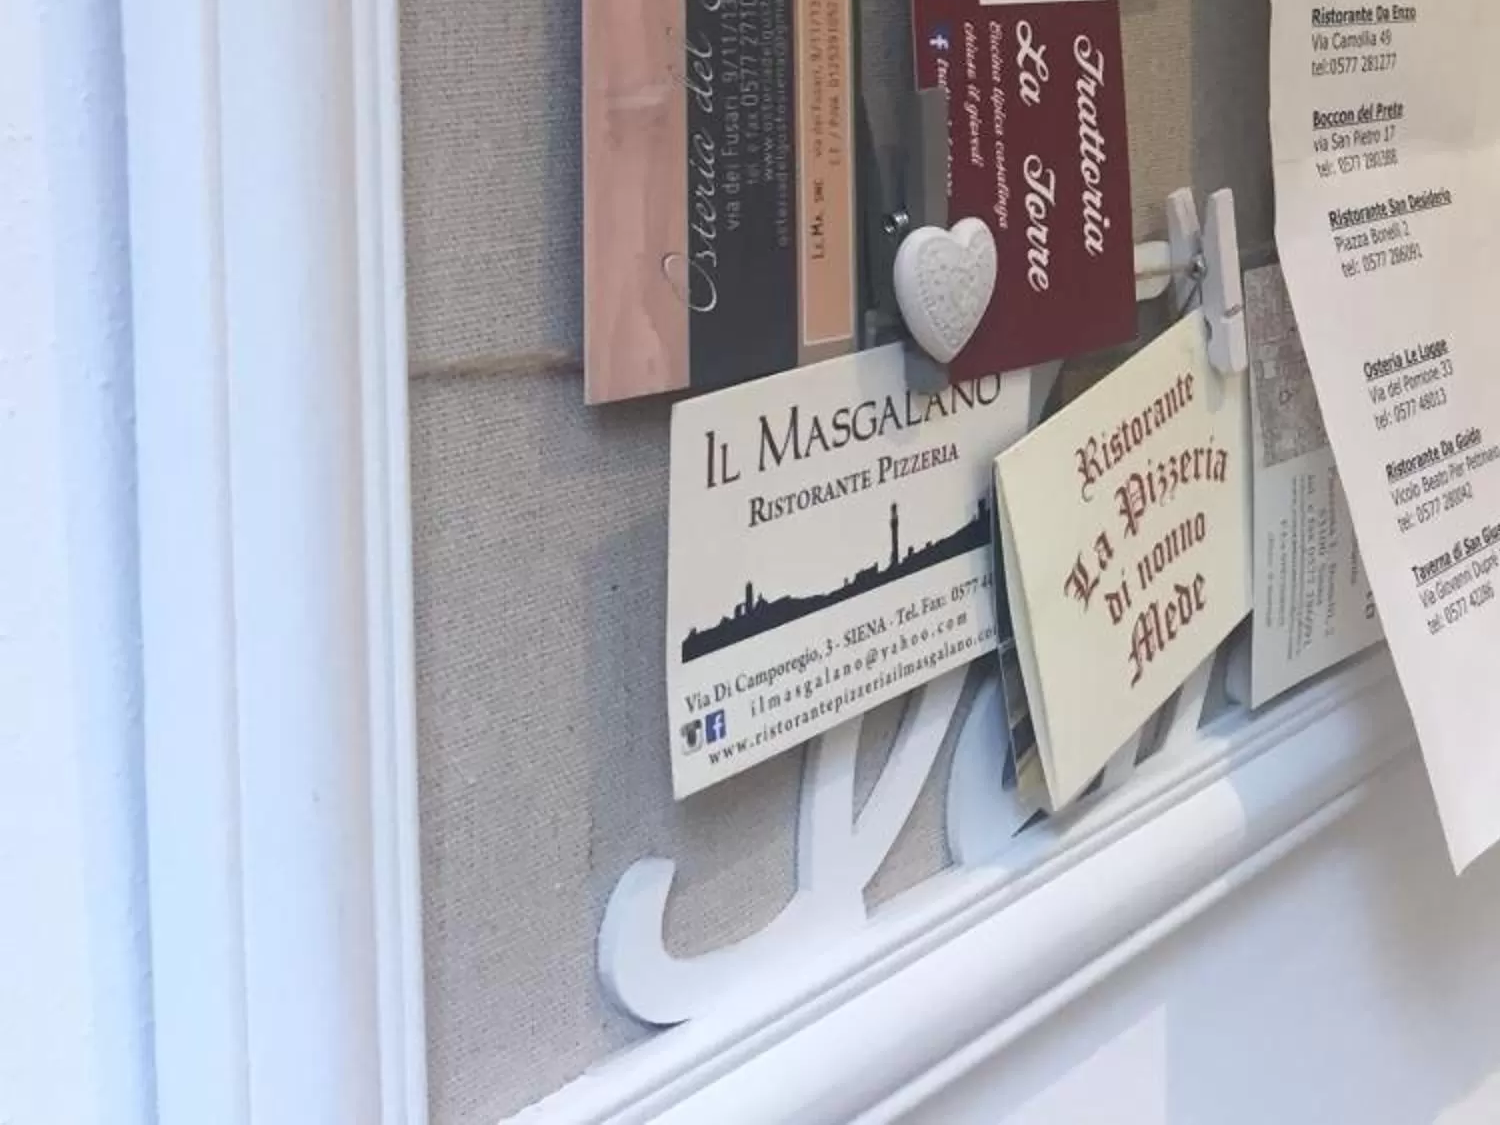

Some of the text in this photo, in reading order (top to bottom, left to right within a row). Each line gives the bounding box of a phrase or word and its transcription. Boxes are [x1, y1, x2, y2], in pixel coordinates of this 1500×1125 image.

[1311, 6, 1374, 26] Ristorante
[1391, 4, 1417, 22] Enzo
[1311, 33, 1329, 52] Via
[668, 32, 715, 114] del
[740, 55, 760, 107] 0577
[990, 86, 1009, 136] tipica
[1313, 109, 1355, 129] Boccon
[1357, 102, 1374, 124] del
[1015, 19, 1057, 293] La Torre
[1072, 34, 1111, 259] Trattoria
[1331, 131, 1351, 151] San
[1383, 124, 1397, 143] 17
[720, 162, 741, 195] dei
[991, 140, 1010, 230] casalinga
[661, 127, 717, 313] Osteria
[722, 199, 742, 231] via
[1328, 202, 1388, 230] Ristorante
[1388, 197, 1407, 218] San
[1333, 231, 1370, 253] Piazza
[1363, 352, 1403, 381] Osteria
[1403, 348, 1419, 366] Le
[705, 373, 1002, 489] IL MASGALANO
[1073, 371, 1196, 504] Ristorante
[748, 442, 960, 528] RISTORANTE PIZZERIA
[1385, 444, 1441, 484] Ristorante
[1390, 480, 1422, 507] Vicolo
[1062, 433, 1231, 614] La Pizzeria
[1103, 581, 1131, 626] di
[1136, 509, 1207, 591] nonno
[1411, 551, 1452, 587] Taverna
[1463, 534, 1483, 556] San
[684, 691, 711, 714] Via
[713, 683, 732, 704] Di
[734, 648, 823, 694] Camporegio,
[824, 638, 834, 656] 3
[843, 617, 887, 647] SIENA
[951, 577, 979, 603] 0577
[1127, 571, 1207, 689] Mede
